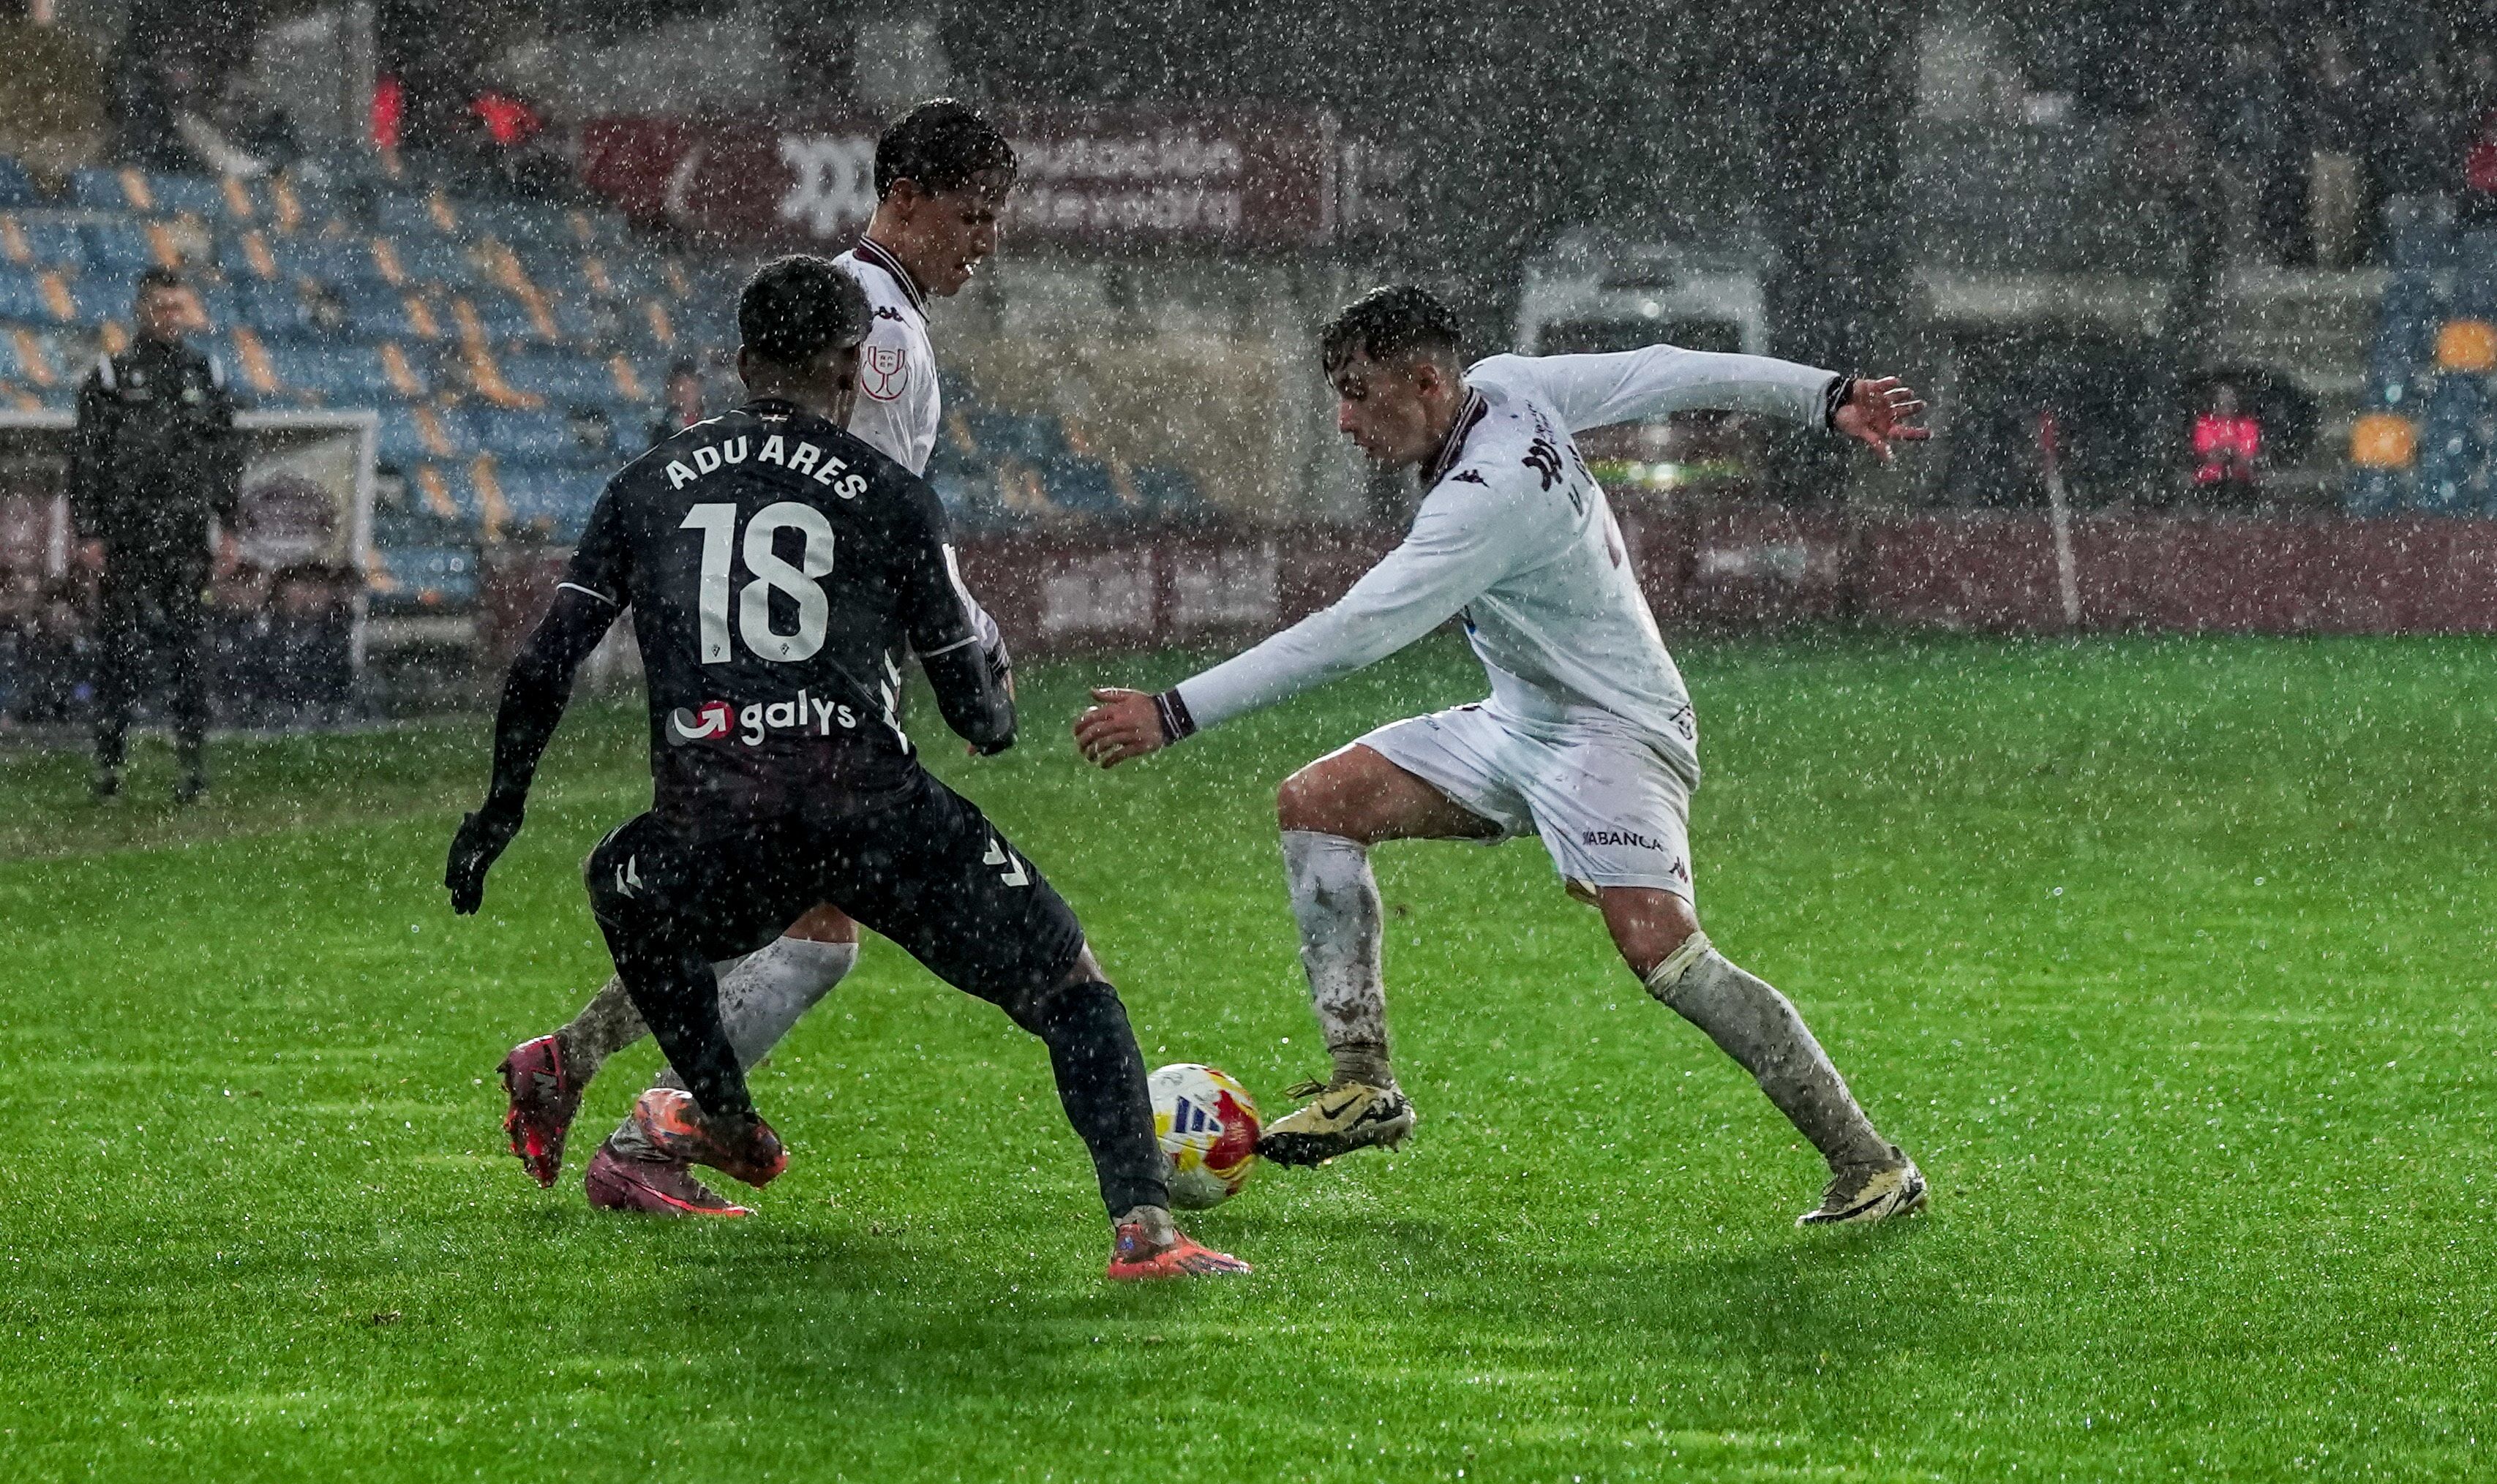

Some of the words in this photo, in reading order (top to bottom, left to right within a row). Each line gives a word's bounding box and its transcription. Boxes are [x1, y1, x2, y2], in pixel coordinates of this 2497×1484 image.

[665, 435, 748, 491] ADU
[758, 434, 868, 500] ARES
[679, 501, 834, 665] 18
[740, 689, 857, 746] galys
[1588, 831, 1664, 852] ABANCA
